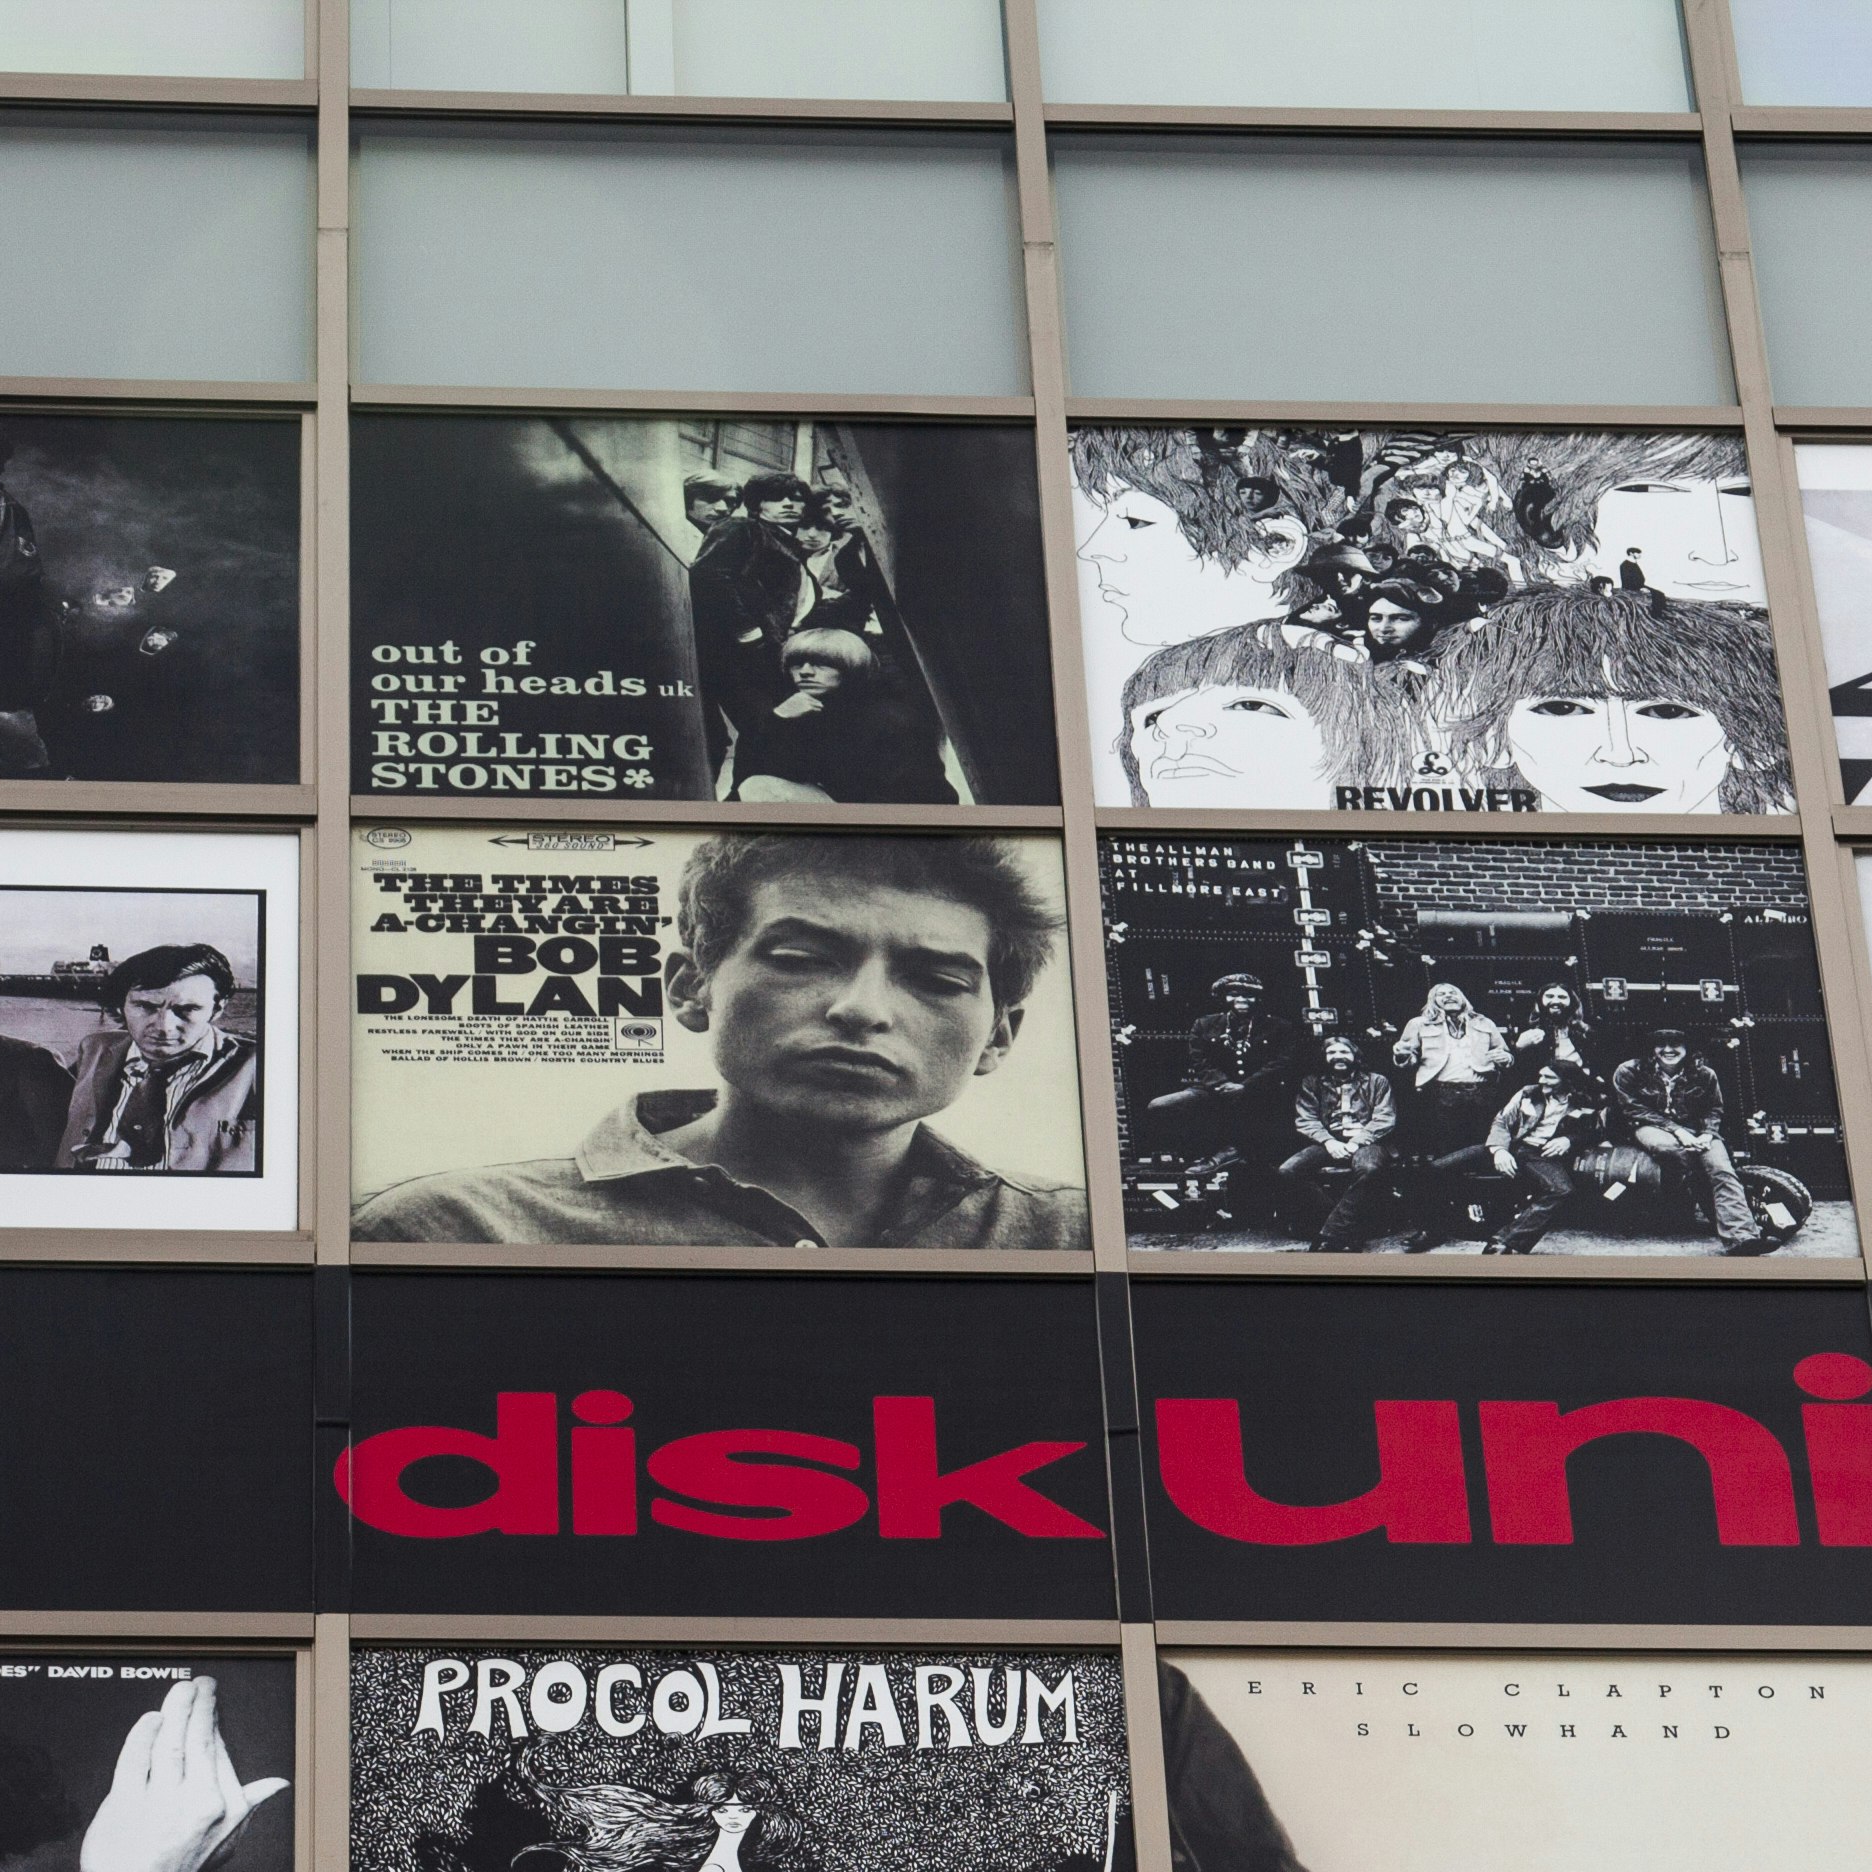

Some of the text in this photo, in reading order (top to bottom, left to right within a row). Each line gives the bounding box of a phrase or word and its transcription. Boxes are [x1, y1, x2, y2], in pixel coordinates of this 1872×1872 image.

[372, 640, 536, 665] out of
[372, 669, 693, 696] our heads uk
[371, 699, 499, 725] THE
[372, 732, 653, 760] ROLLING
[1336, 786, 1539, 812] REVOLVER
[532, 834, 611, 843] STEREO
[1112, 853, 1277, 871] BROTHERS BAND
[1114, 867, 1138, 879] AT
[374, 873, 660, 895] THE TIMES
[1115, 881, 1280, 898] FILLMORE EAST
[403, 893, 659, 915] THEY ARE
[474, 934, 662, 976] BOB
[357, 974, 663, 1017] DYLAN
[334, 1390, 1104, 1540] disk
[48, 1666, 113, 1678] DAVID
[121, 1667, 190, 1679] BOWIE
[1248, 1681, 1824, 1699] ERIC CLAPTON
[411, 1658, 1081, 1752] PROCOL HARUM
[1358, 1723, 1730, 1738] SLOWHAND
